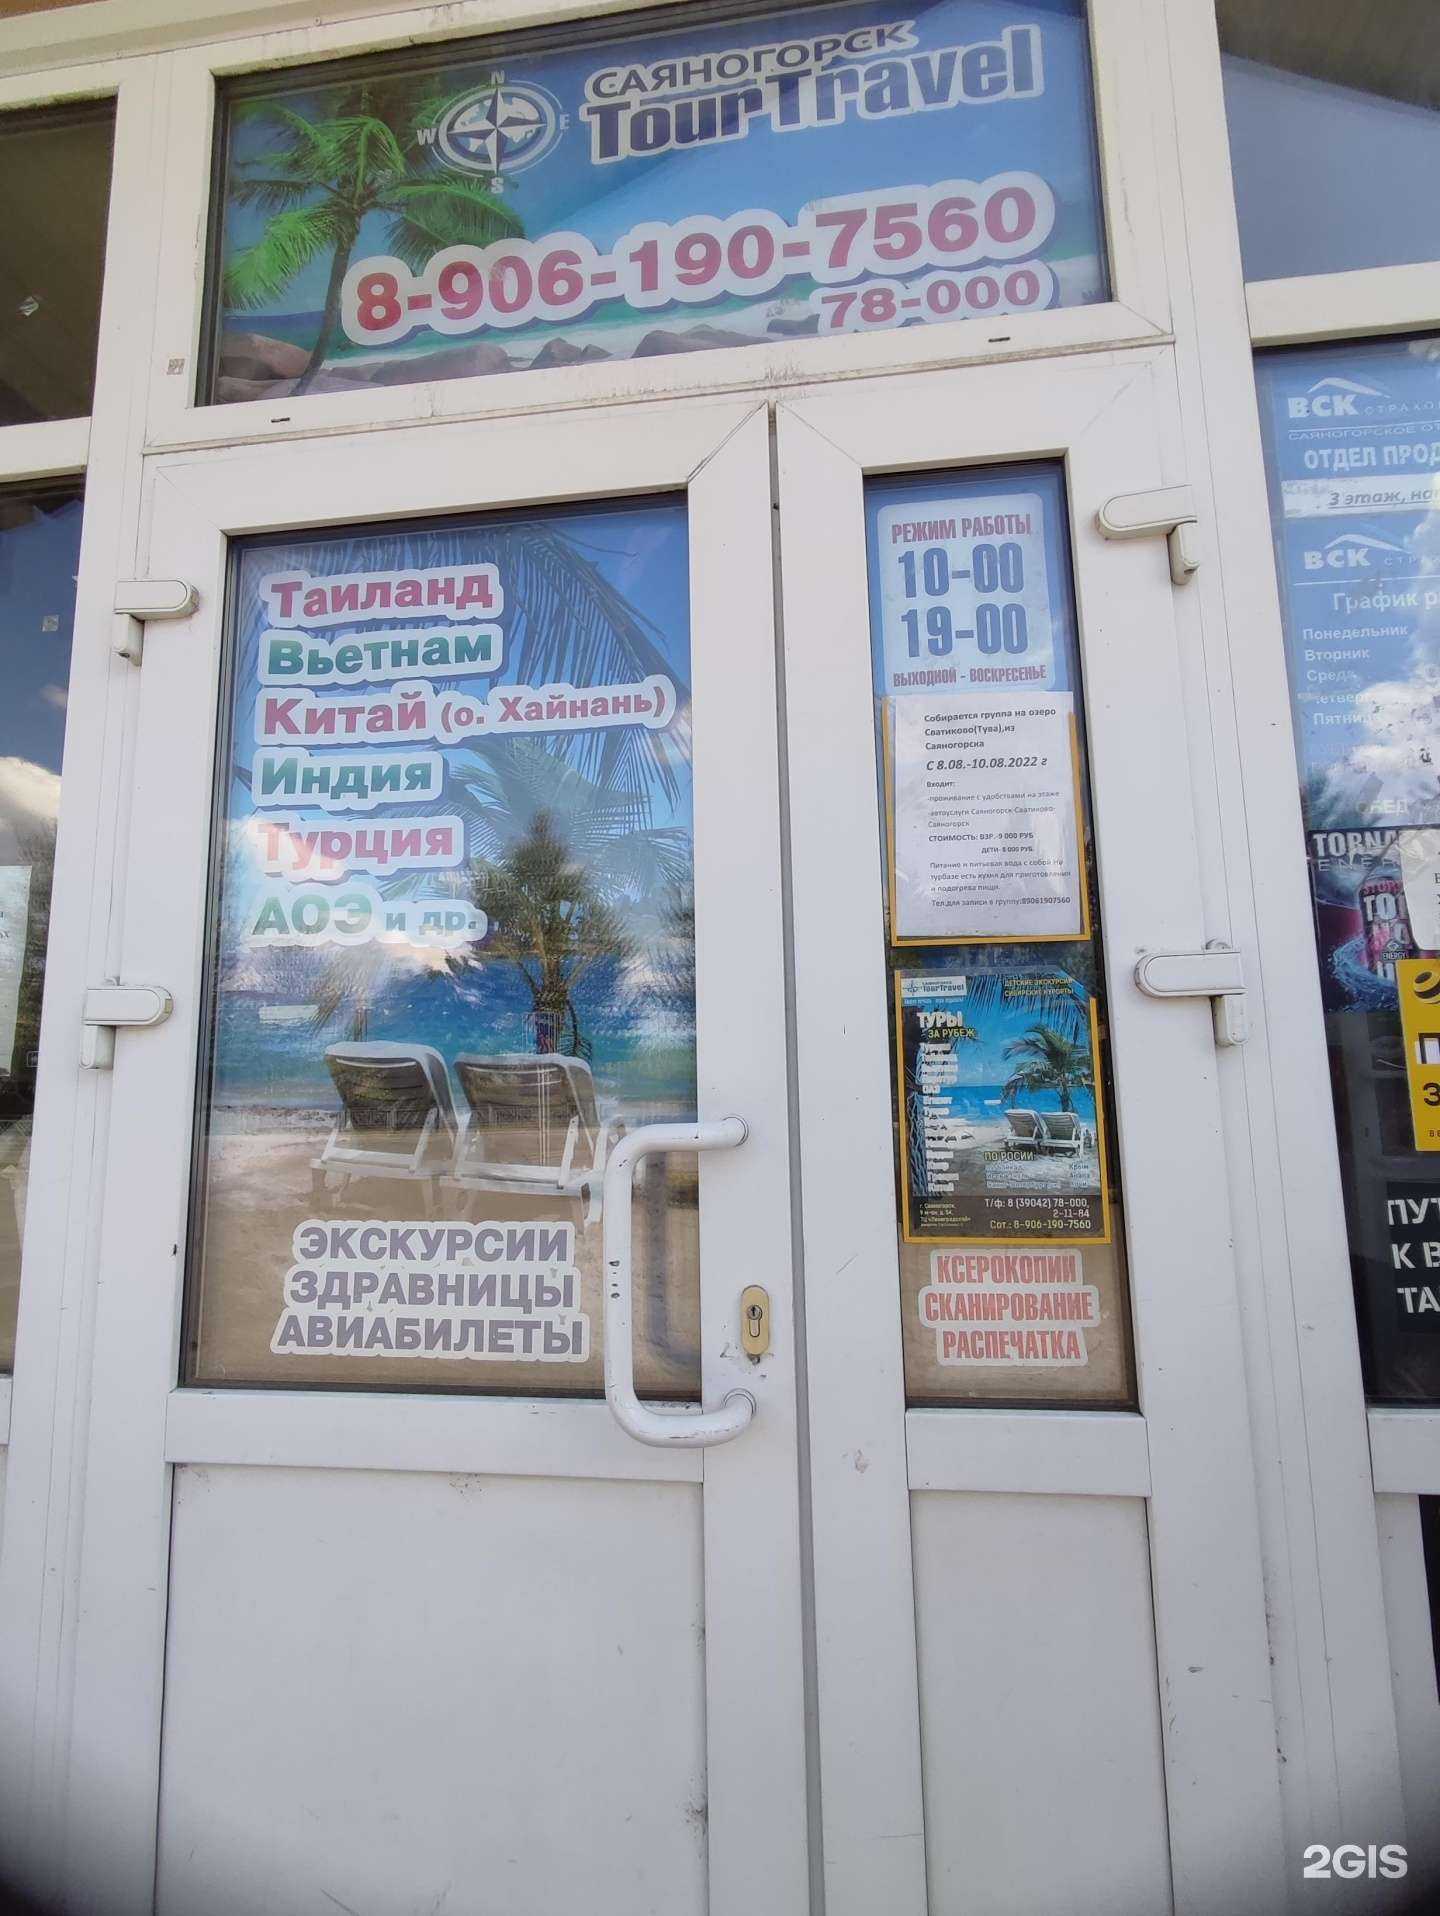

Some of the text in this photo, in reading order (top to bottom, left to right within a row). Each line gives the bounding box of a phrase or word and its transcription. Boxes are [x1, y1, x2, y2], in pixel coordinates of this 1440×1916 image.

[590, 22, 916, 98] САЯНОГОРСК
[586, 28, 1035, 160] TourTravel
[416, 127, 438, 146] W
[559, 113, 570, 130] E
[355, 186, 1037, 332] 8-906-190-7560
[821, 269, 1041, 329] 78-000
[1287, 393, 1440, 418] ВСК СТРАХО
[1303, 447, 1377, 472] ОТДЕЛ
[891, 513, 1032, 545] РЕЖИМ РАБОТЫ
[897, 541, 1025, 599] 10-00
[1303, 548, 1371, 570] ВСК
[270, 573, 494, 618] Таиланд
[900, 602, 1029, 658] 19-00
[1302, 626, 1409, 641] Понедельник
[267, 633, 492, 676] Вьетнам
[1304, 649, 1371, 662] Вторник
[893, 666, 957, 688] ВЫХОДНОЙ
[969, 664, 1047, 683] ВОСКРЕСЕНЬЕ
[263, 684, 667, 736] Китай (о. Хайнань)
[924, 708, 1057, 724] Собирается группа на озеро
[925, 740, 985, 751] Саяногорска
[261, 757, 433, 800] Индия
[258, 821, 454, 872] Турция
[252, 892, 478, 938] АОЭ и др.
[916, 1010, 963, 1028] ТУРЫ
[928, 1027, 976, 1039] ЗА РУБЕЖ
[984, 1151, 1035, 1161] ПО РОСИИ
[1007, 1199, 1013, 1208] 8
[299, 1226, 569, 1263] ЭКСКУРСИИ
[1391, 1242, 1417, 1270] К
[937, 1254, 1077, 1284] КСЕРОКОПИИ
[289, 1270, 575, 1315] ЗДРАВНИЦЫ
[924, 1291, 1094, 1321] СКАНИРОВАНИЕ
[276, 1314, 583, 1356] АВИАБИЛЕТЫ
[942, 1330, 1081, 1360] РАСПЕЧАТКА
